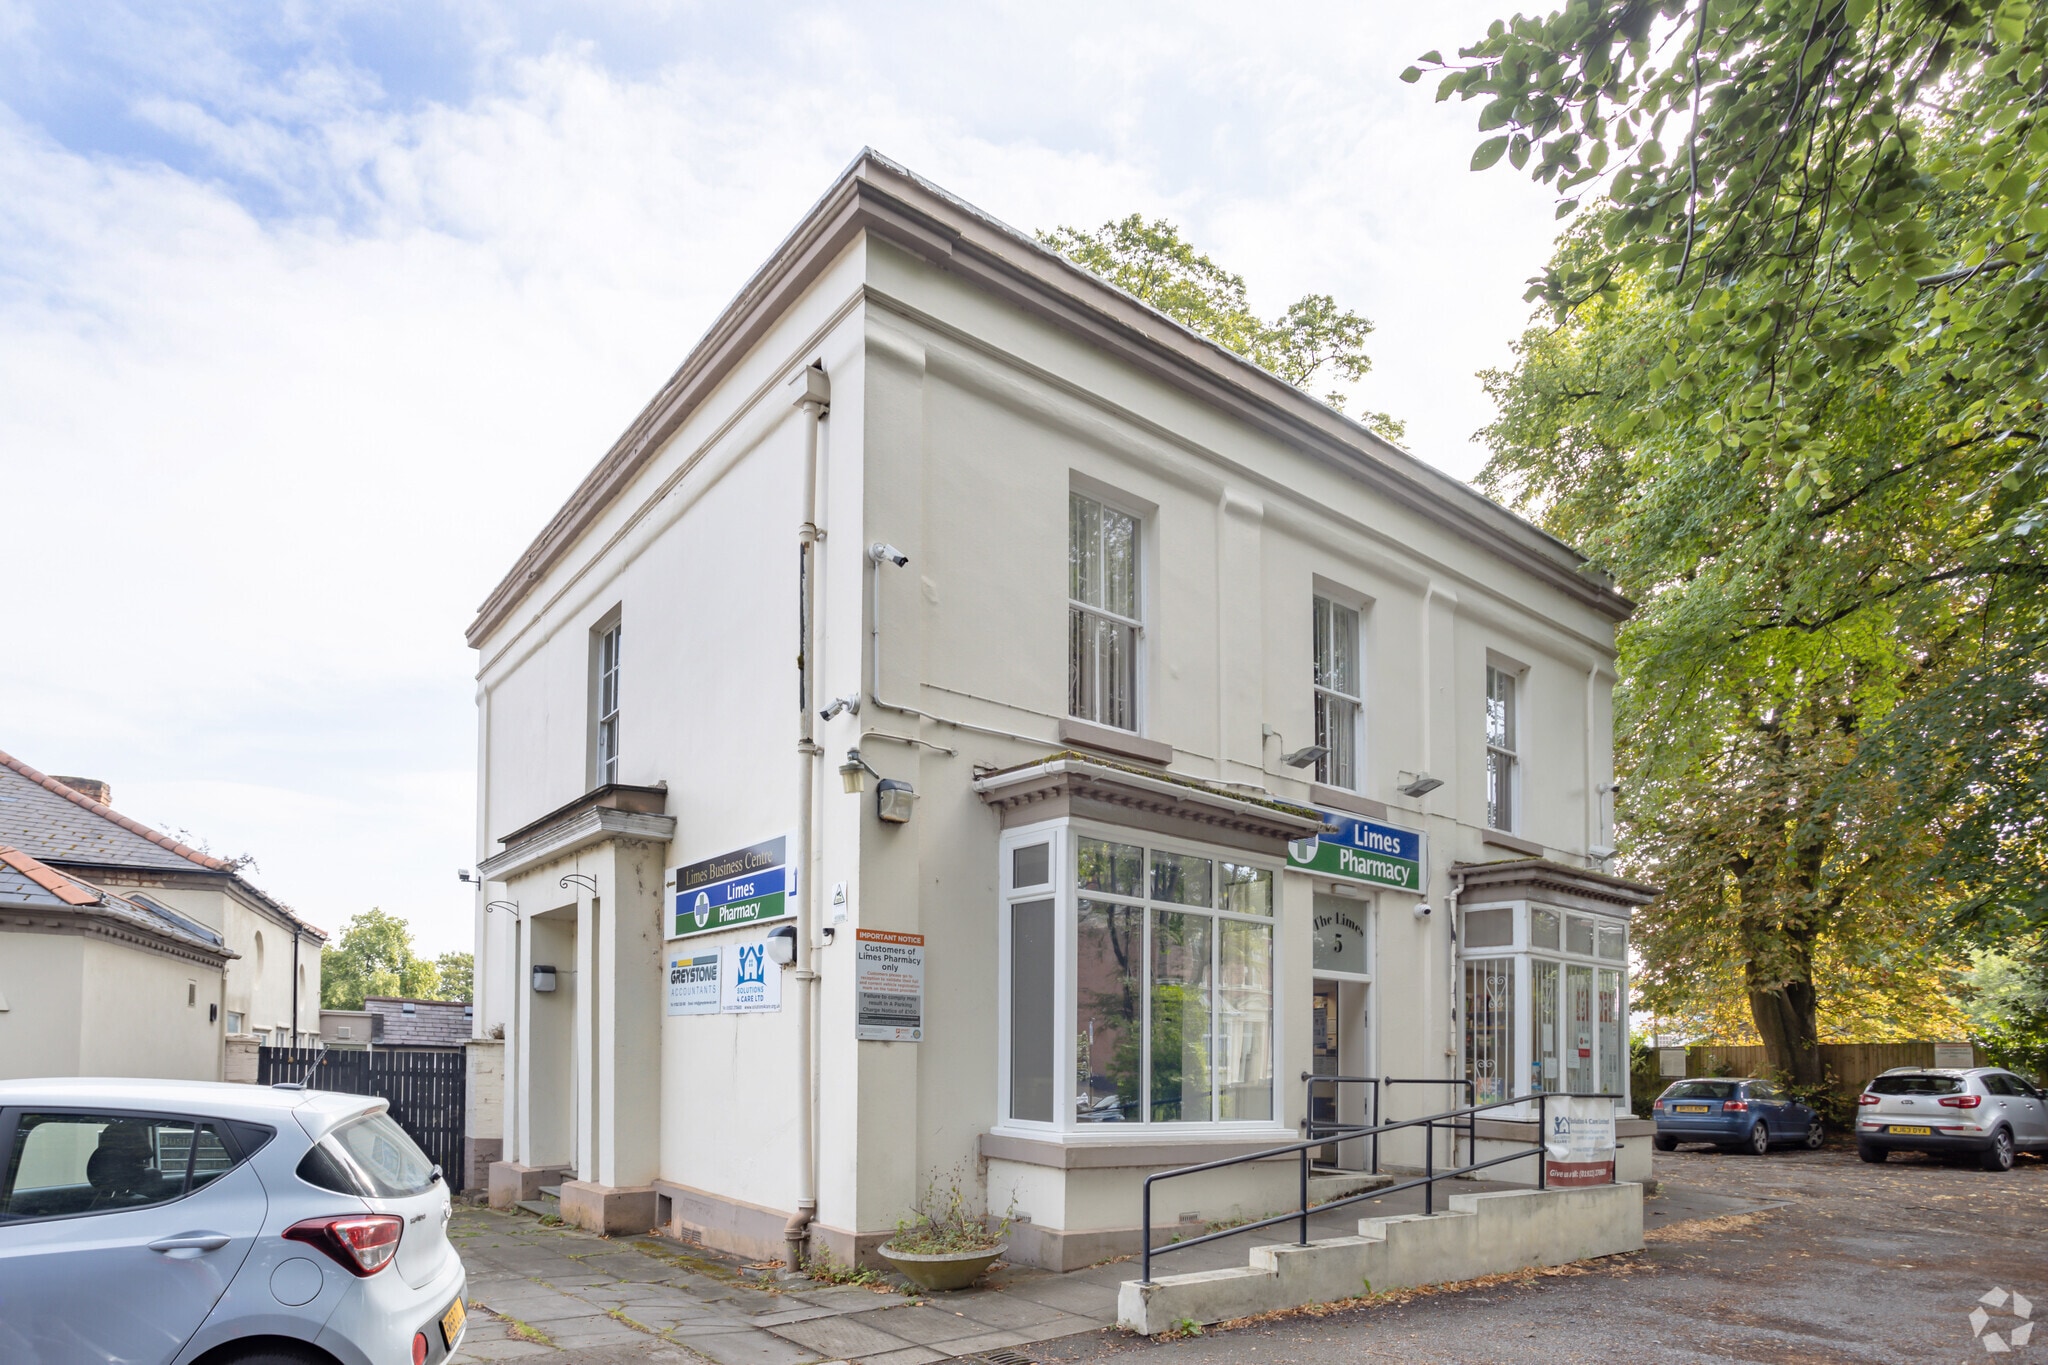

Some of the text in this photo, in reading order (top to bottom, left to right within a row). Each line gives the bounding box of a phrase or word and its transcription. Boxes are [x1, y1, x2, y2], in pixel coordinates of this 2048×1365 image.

[1354, 823, 1401, 854] Limes
[686, 851, 773, 886] Limes Business Centre
[1340, 848, 1410, 886] Pharmacy
[727, 882, 755, 900] Limes
[719, 902, 761, 922] Pharmacy
[1313, 912, 1364, 937] The Limes
[859, 931, 922, 944] IMPORTANT NOTICE
[1334, 933, 1342, 953] 5
[864, 943, 906, 955] Customers
[858, 951, 921, 966] Limes Pharmacy
[671, 965, 717, 985] GREYSTONE
[881, 963, 899, 973] only
[671, 984, 717, 997] ACCOUNTANTS
[737, 986, 764, 995] SOLUTIONS
[740, 995, 754, 1003] CARE
[754, 994, 764, 1002] LTD
[894, 1001, 913, 1009] Parking
[160, 1135, 211, 1146] Businss
[1549, 1169, 1564, 1178] Give
